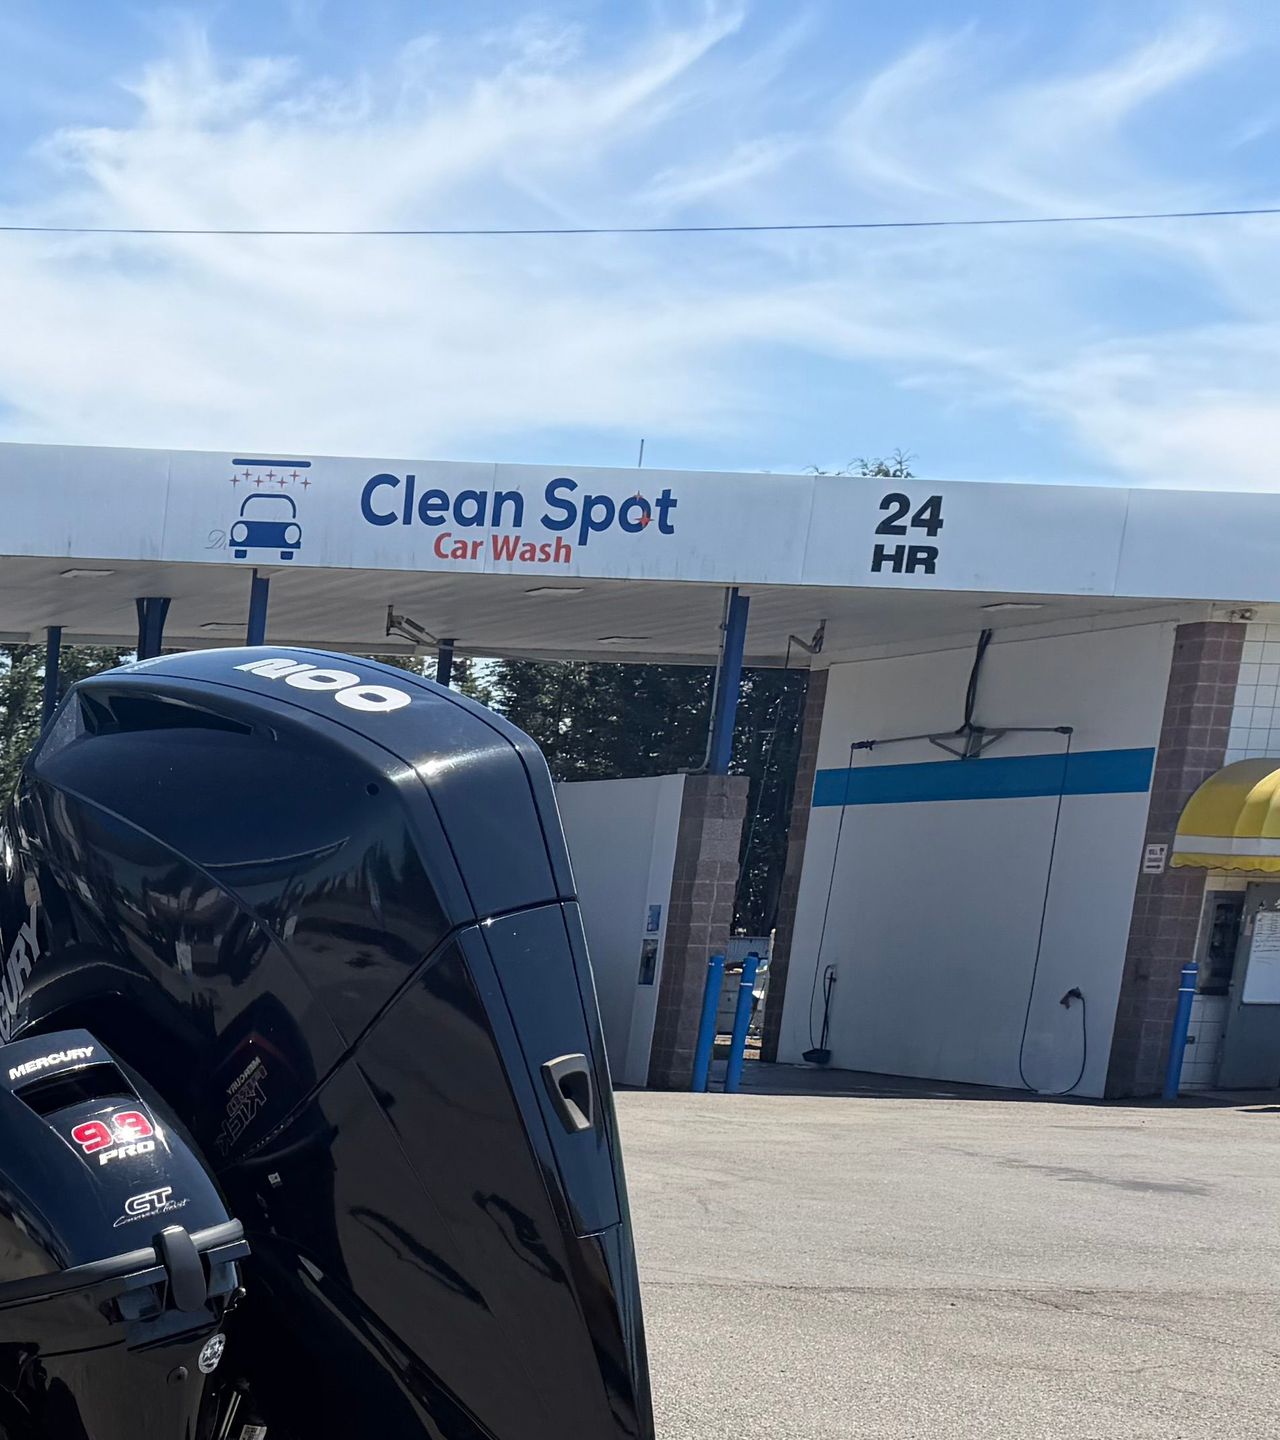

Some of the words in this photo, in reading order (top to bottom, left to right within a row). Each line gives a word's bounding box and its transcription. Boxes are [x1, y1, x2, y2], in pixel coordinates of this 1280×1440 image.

[361, 473, 525, 527] Clean
[540, 477, 678, 546] Spot
[875, 492, 944, 537] 24
[433, 532, 484, 561] Car
[491, 534, 572, 563] Wash
[871, 543, 939, 575] HR
[8, 1046, 94, 1080] MERCURY
[99, 1140, 155, 1166] PRO
